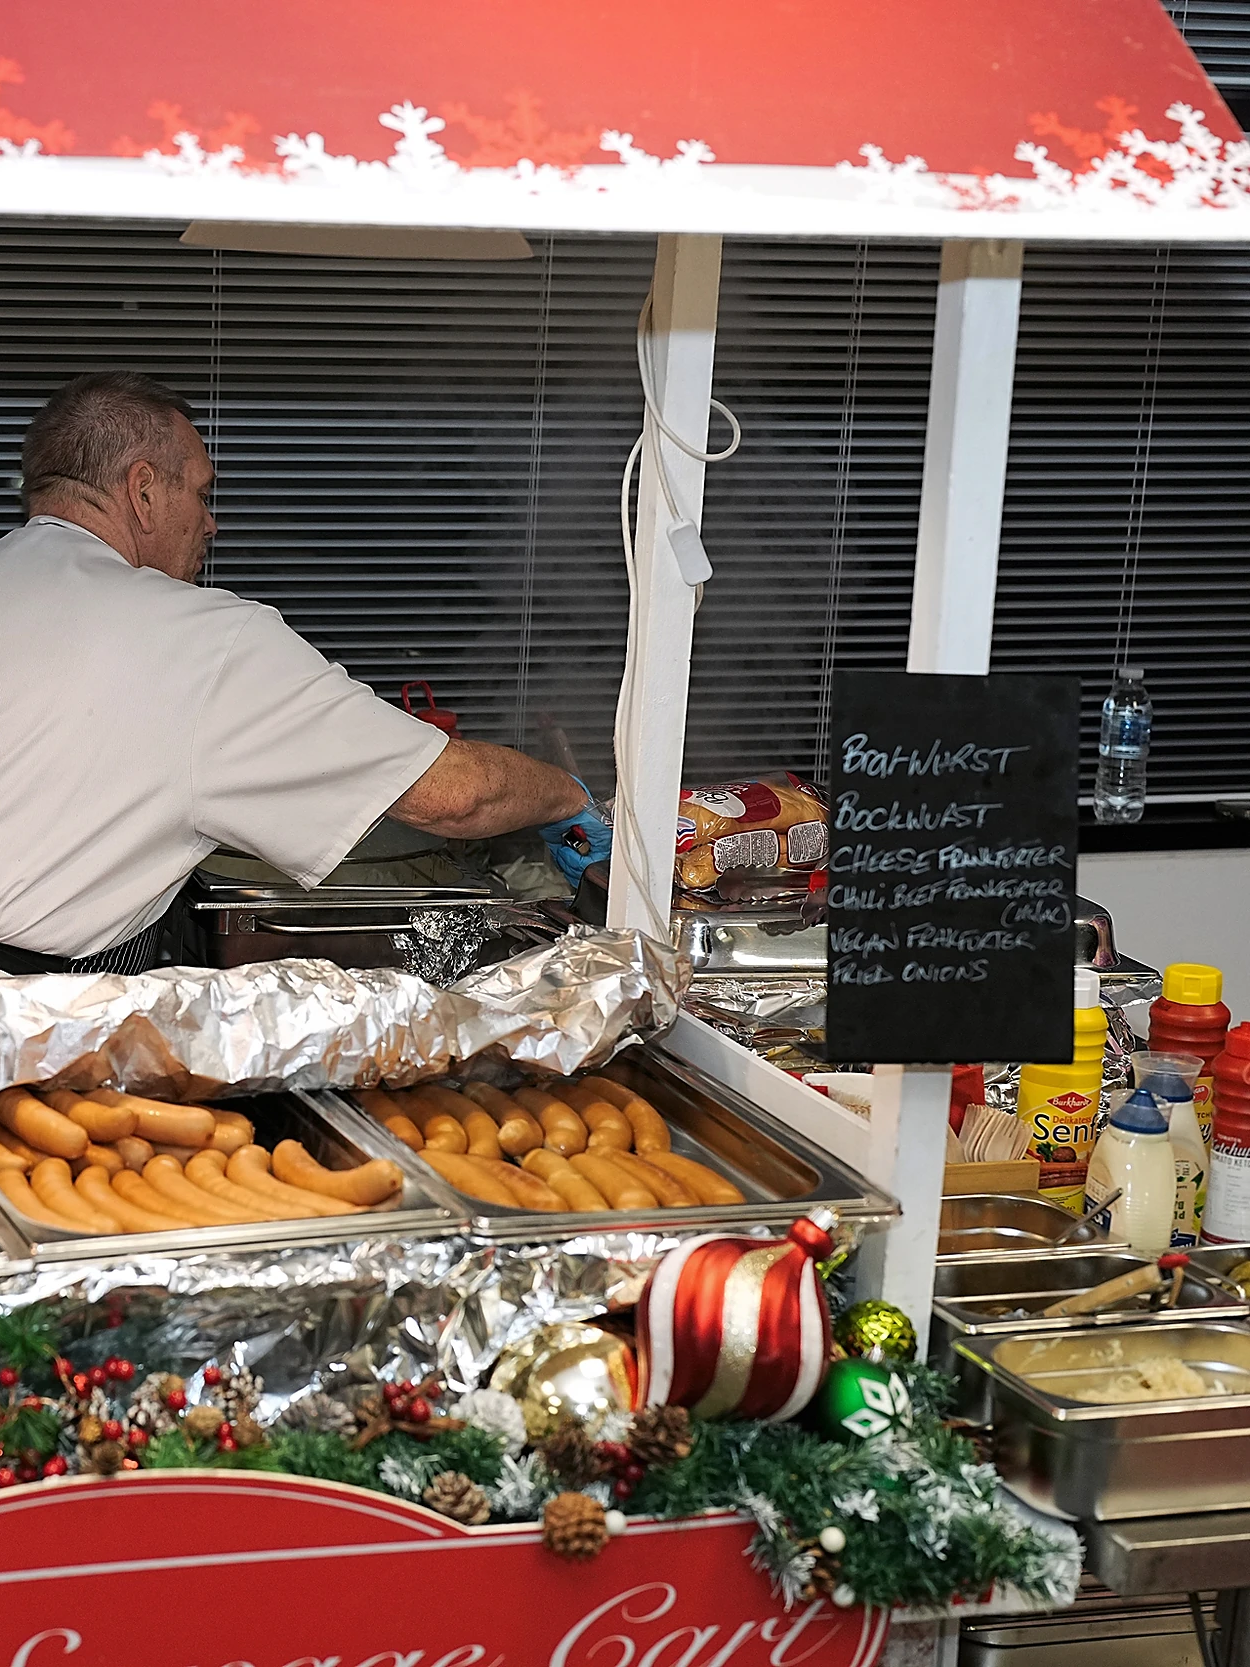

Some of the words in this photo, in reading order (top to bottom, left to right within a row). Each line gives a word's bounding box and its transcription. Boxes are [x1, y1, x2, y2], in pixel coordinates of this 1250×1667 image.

[828, 843, 937, 875] CHEESE
[901, 958, 990, 983] ONIONS
[1032, 1112, 1098, 1144] Senf
